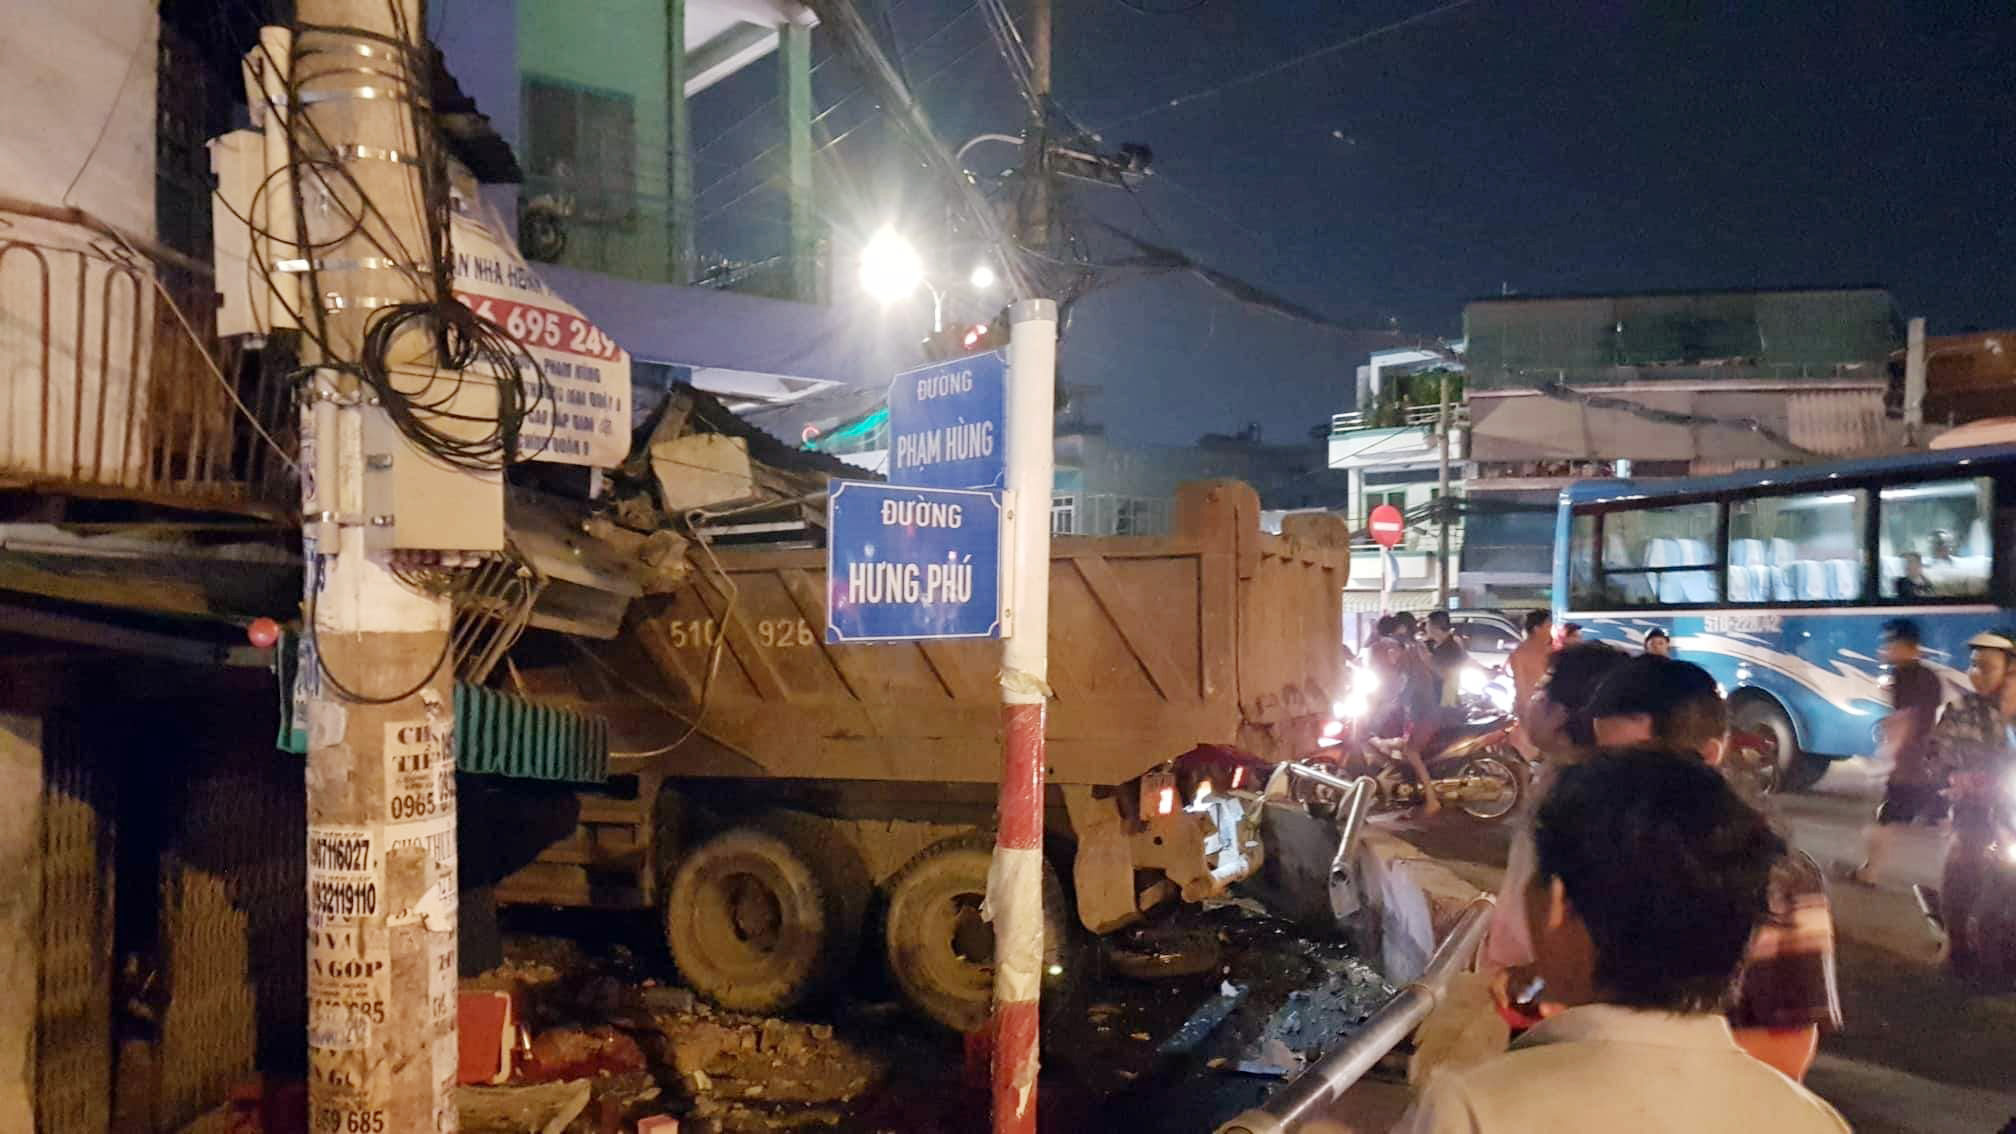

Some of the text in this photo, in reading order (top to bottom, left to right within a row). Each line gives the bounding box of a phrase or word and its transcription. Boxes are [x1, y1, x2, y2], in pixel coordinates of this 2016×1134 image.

[507, 306, 561, 347] 695
[917, 369, 973, 401] ĐƯỜNG
[896, 416, 994, 471] PHẠM HÙNG
[881, 494, 962, 528] ĐƯỜNG
[849, 553, 973, 604] HƯNG PHÚ
[347, 1109, 385, 1134] 685
